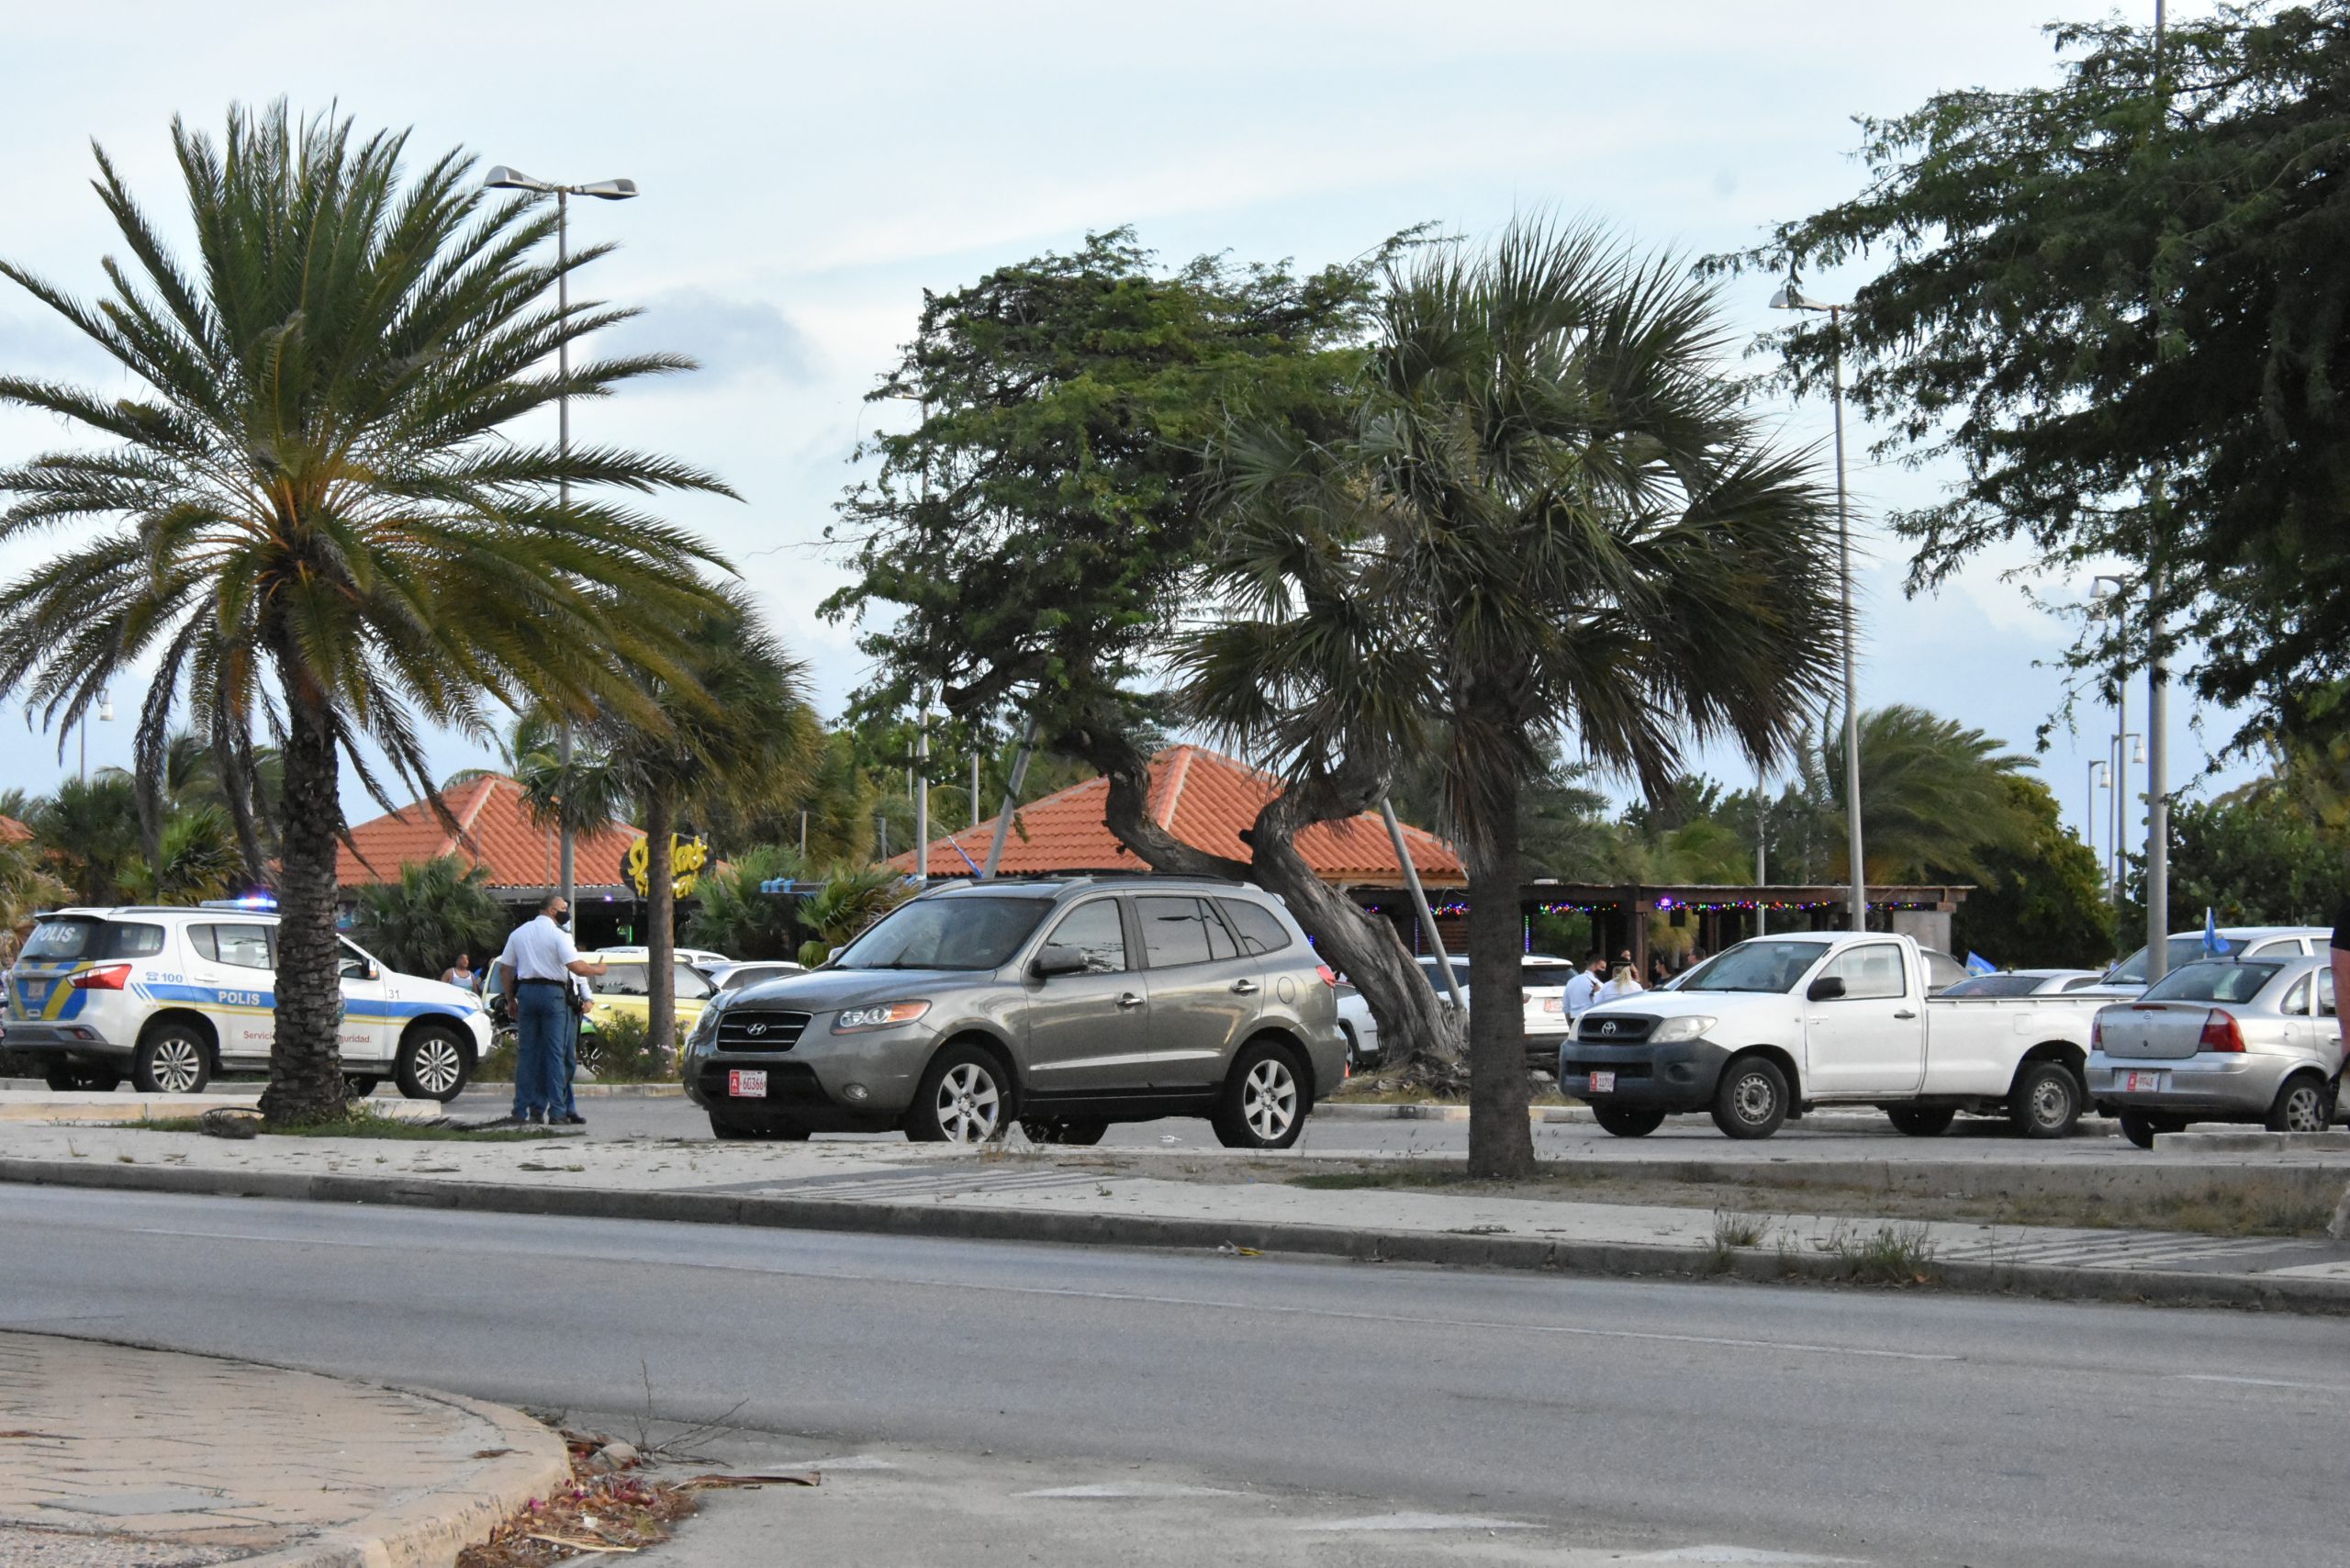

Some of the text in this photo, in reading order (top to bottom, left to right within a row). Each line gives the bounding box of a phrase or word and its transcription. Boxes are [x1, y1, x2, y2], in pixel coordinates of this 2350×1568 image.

[33, 925, 75, 943] POLIS
[162, 973, 183, 983] 100
[218, 991, 261, 1006] POLIS
[388, 989, 399, 1000] 31
[243, 1030, 274, 1040] Servici
